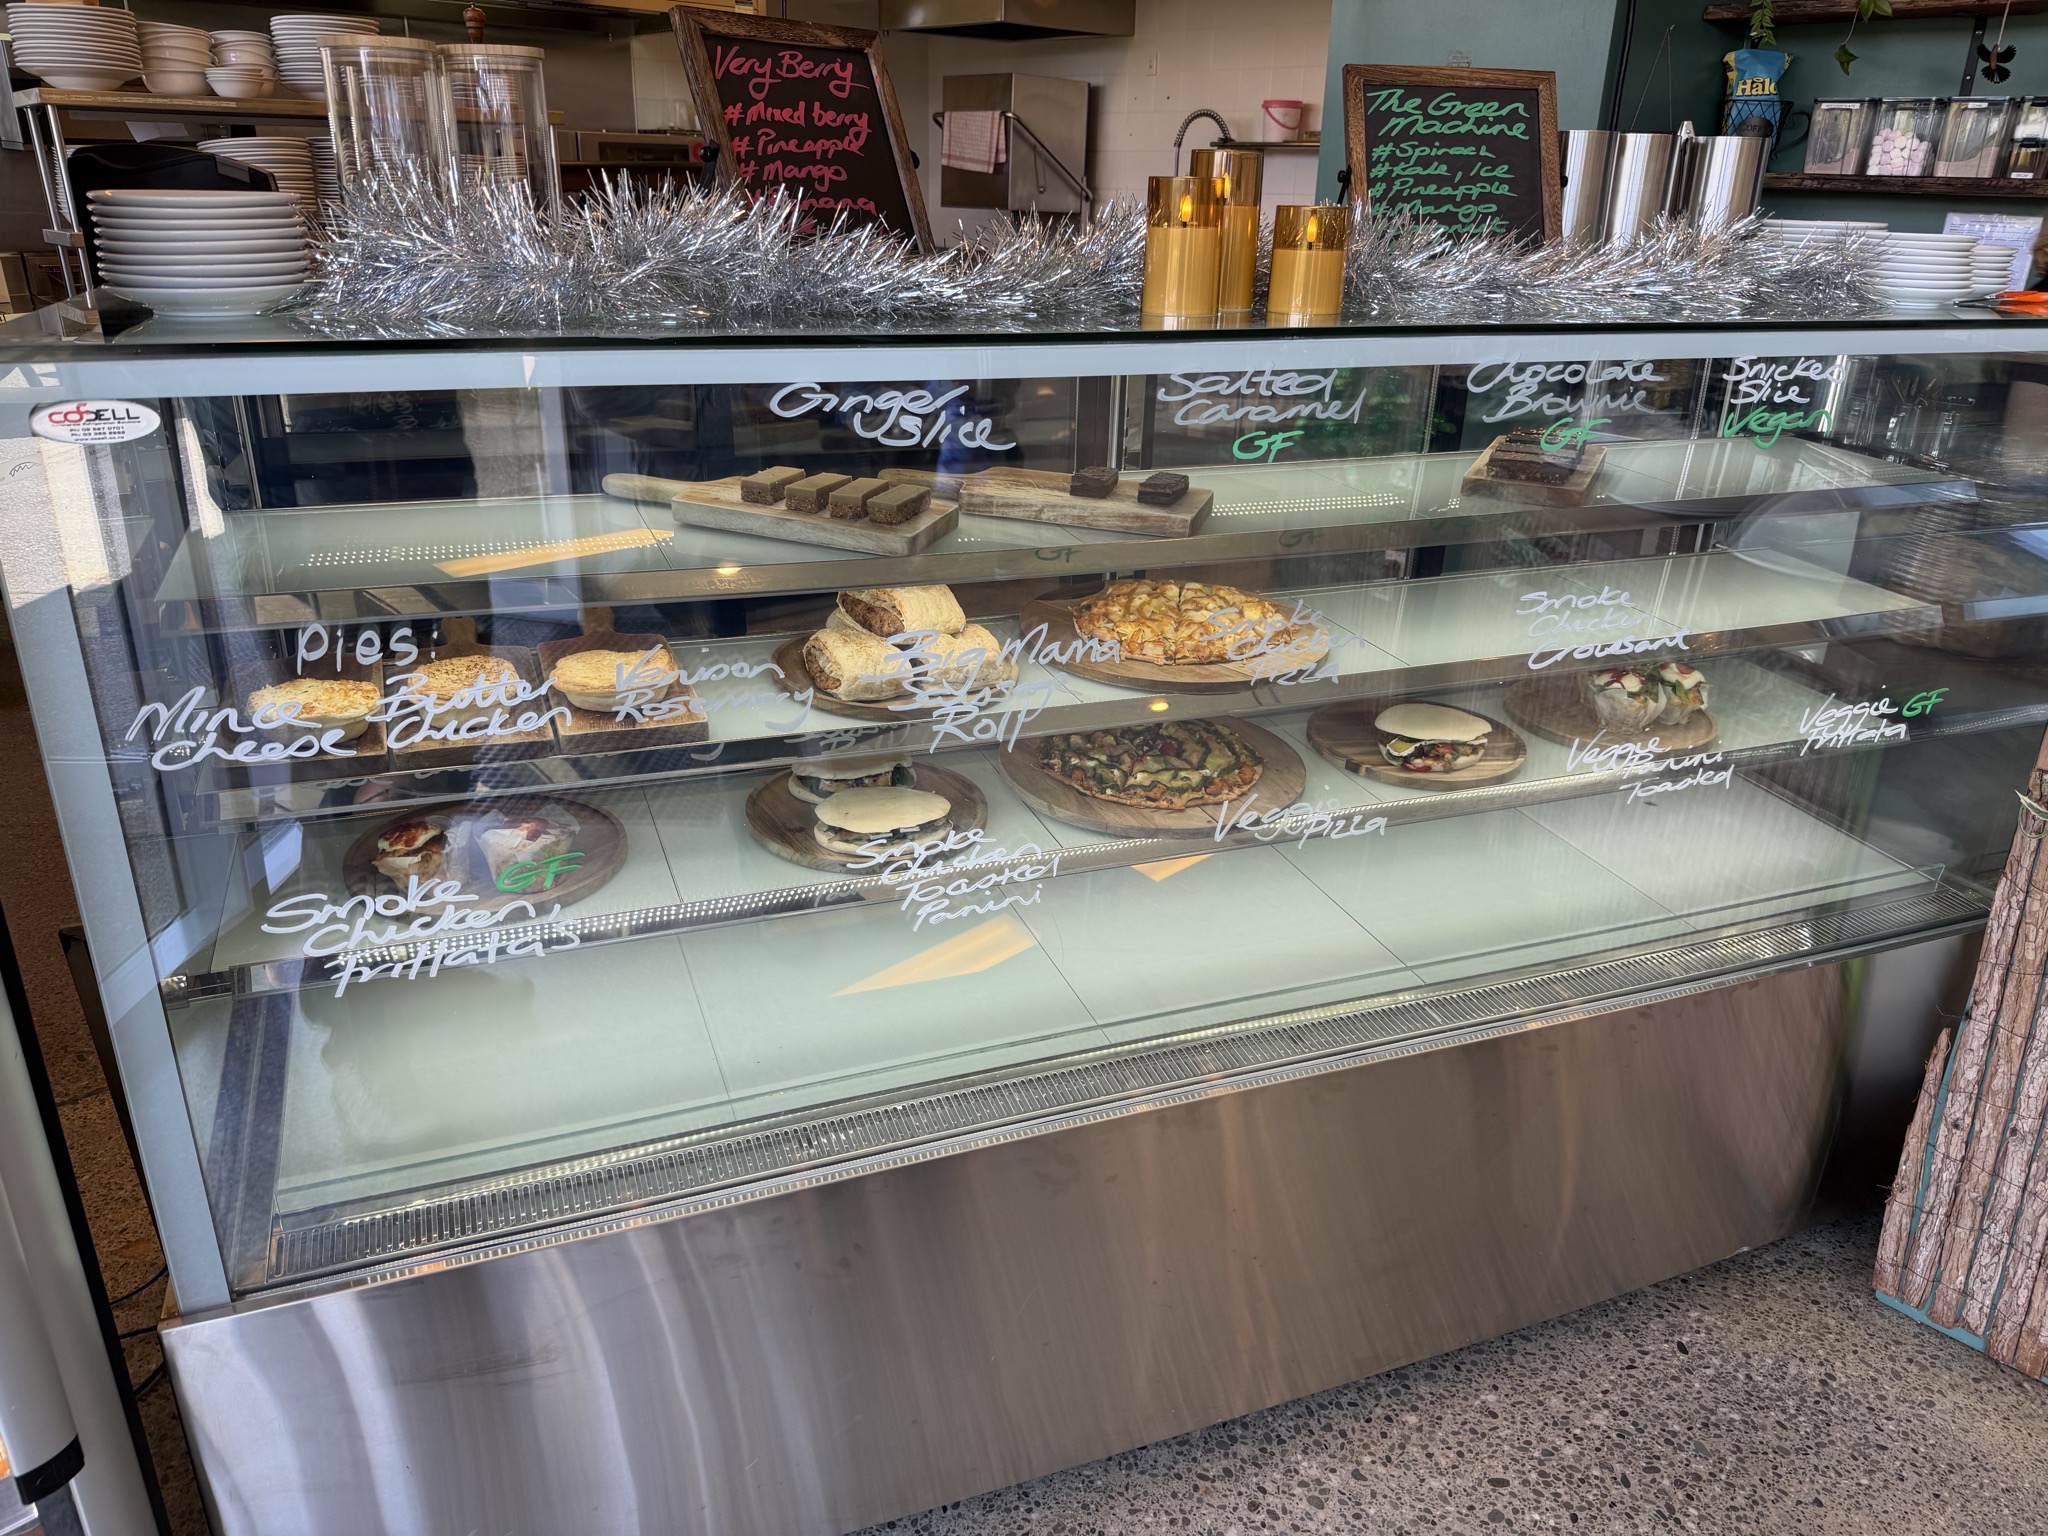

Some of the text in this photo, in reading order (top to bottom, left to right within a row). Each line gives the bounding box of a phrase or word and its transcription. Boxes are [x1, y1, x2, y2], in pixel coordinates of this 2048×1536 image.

[714, 45, 870, 100] Very Berry
[1367, 89, 1530, 118] The Green
[1378, 115, 1530, 140] Machine
[1157, 361, 1339, 402] Salted
[1467, 352, 1665, 393] Chocolate
[1730, 379, 1810, 404] Slice
[769, 382, 969, 438] Ginger
[1174, 387, 1367, 425] Caramel
[1482, 382, 1656, 423] Brownie
[877, 405, 1016, 450] Slice
[1233, 430, 1305, 463] GF
[1540, 417, 1612, 451] GF
[1723, 405, 1832, 449] Vegan
[1200, 599, 1331, 641] Smoke
[1515, 586, 1636, 615] Smoke
[860, 622, 1121, 698] Big Mama
[1227, 629, 1366, 660] Chicken
[615, 643, 786, 691] Venison
[1247, 655, 1340, 687] Pizza
[125, 686, 322, 741] Mince
[365, 669, 559, 721] Butter
[612, 687, 815, 732] Rosemary
[1799, 685, 1950, 738] Veggie GF
[387, 707, 572, 748] Chicken
[929, 700, 1028, 755] Roll
[152, 728, 358, 771] Cheese
[1565, 727, 1673, 773] Veggie
[1622, 739, 1724, 780] Panini
[1618, 764, 1735, 805] Toasted
[1213, 785, 1341, 842] Veggie
[846, 828, 998, 869] Smoke
[881, 843, 1042, 885] Chicken
[495, 852, 586, 892] GF
[895, 857, 1059, 911] Toasted
[261, 875, 480, 934] Smoke
[913, 884, 1043, 932] Panini
[302, 900, 537, 956] Chicken
